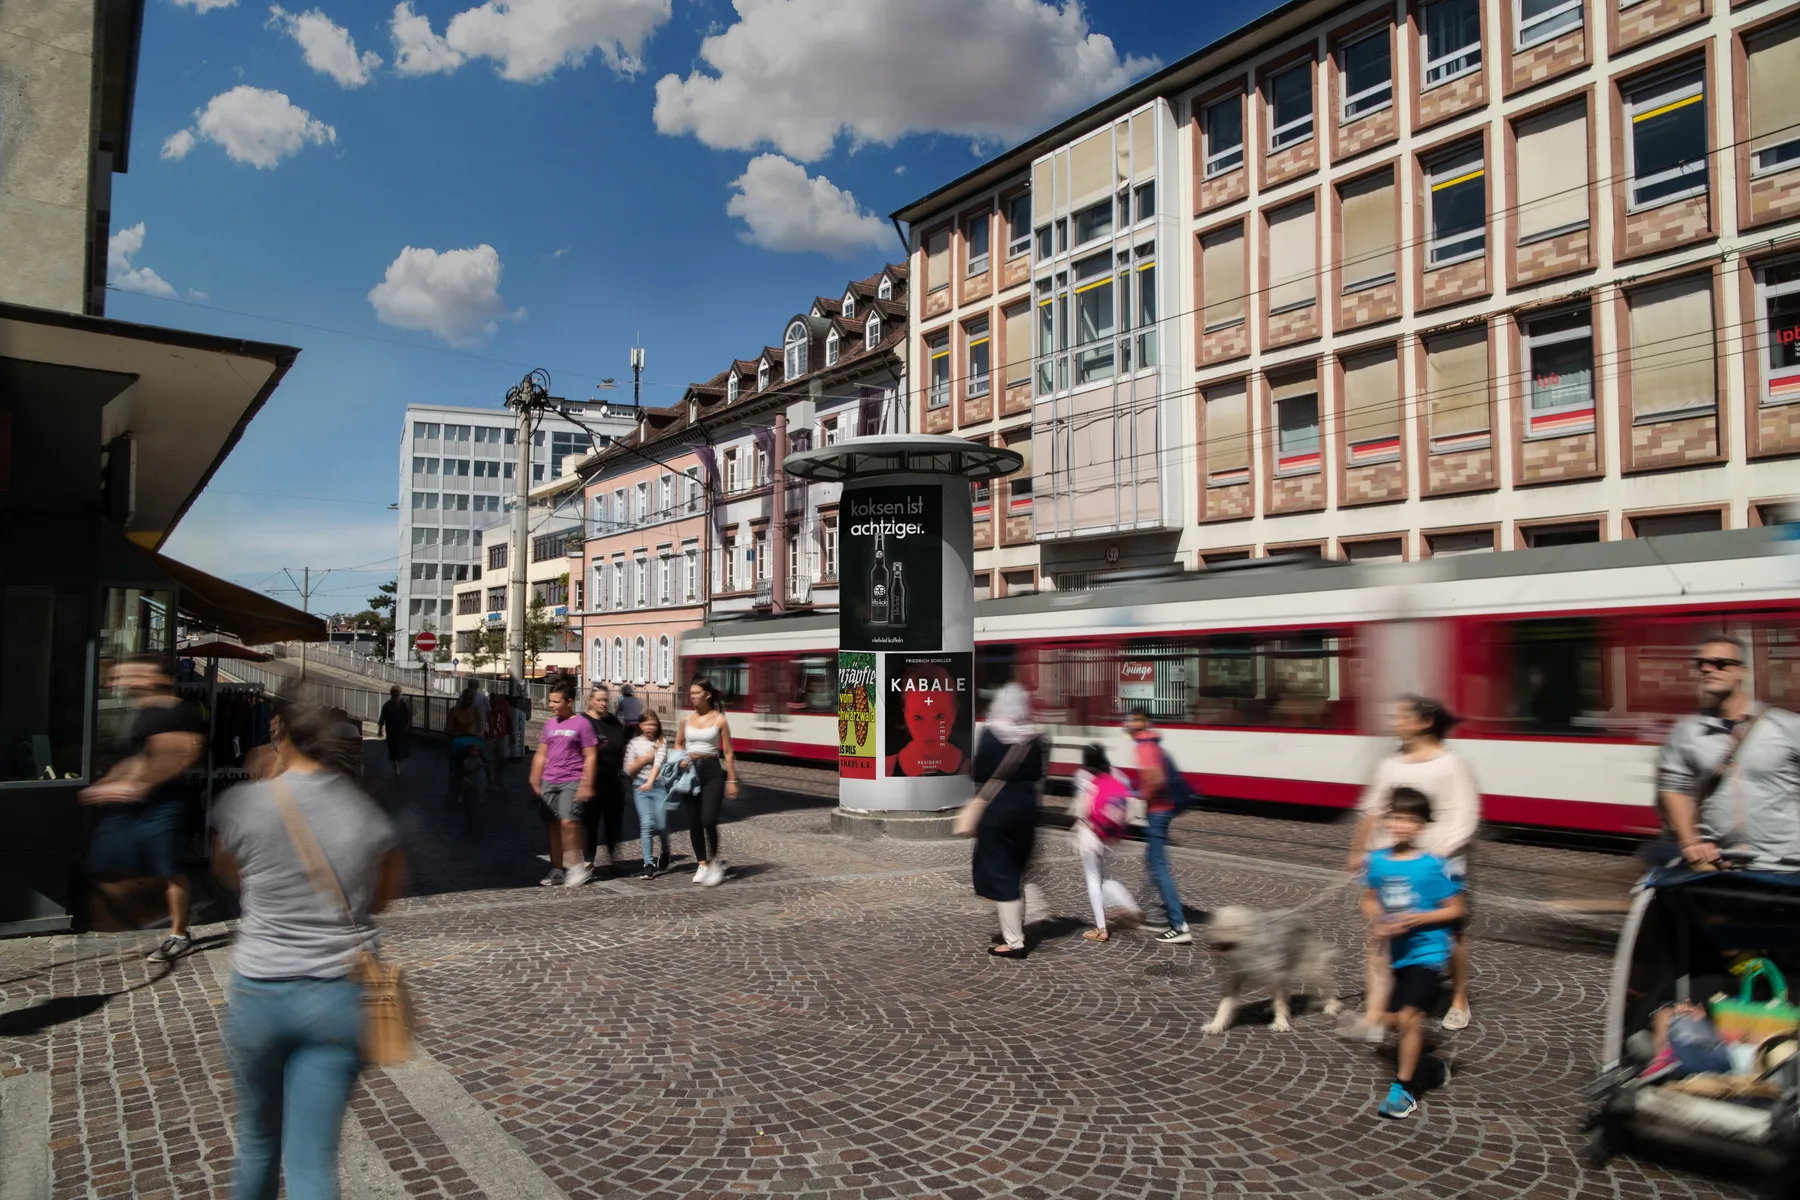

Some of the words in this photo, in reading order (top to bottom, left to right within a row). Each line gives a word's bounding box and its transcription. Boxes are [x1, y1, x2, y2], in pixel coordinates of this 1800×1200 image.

[851, 497, 904, 517] koksen
[907, 495, 923, 514] ist
[850, 516, 925, 539] achtziger.
[1121, 661, 1152, 681] Lounge
[891, 677, 966, 692] KABALE
[839, 693, 854, 704] vom
[845, 745, 857, 755] PILS
